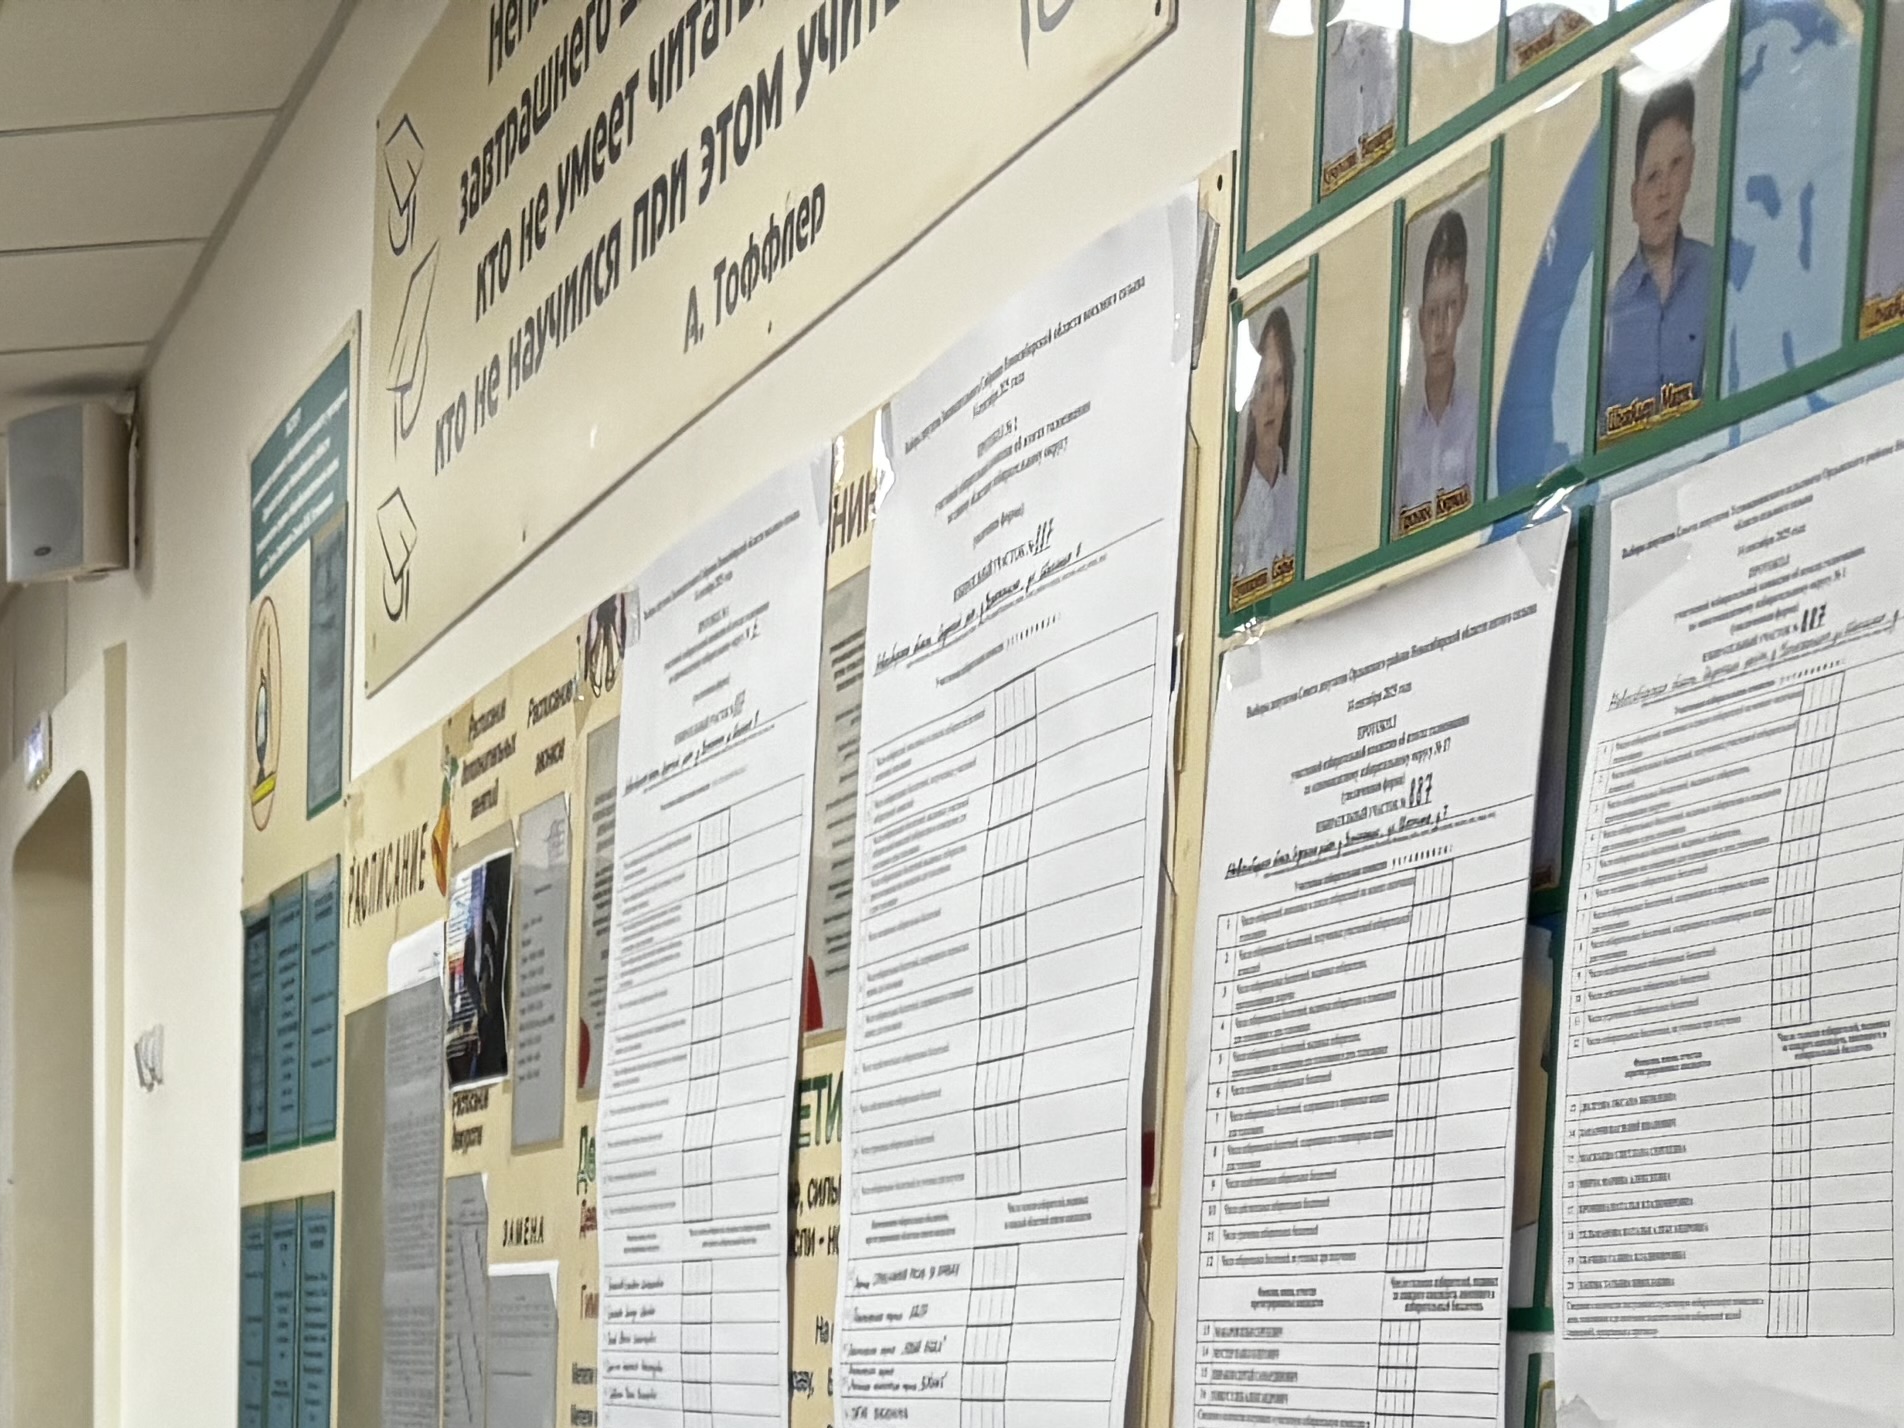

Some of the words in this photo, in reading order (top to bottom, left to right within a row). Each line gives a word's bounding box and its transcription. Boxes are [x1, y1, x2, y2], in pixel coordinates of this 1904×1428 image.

[459, 0, 611, 233] завтрашнего
[475, 228, 512, 322] кто
[518, 188, 548, 272] не
[554, 68, 640, 236] умеет
[434, 390, 468, 477] кто
[473, 353, 502, 436] не
[507, 219, 623, 400] научился
[631, 155, 691, 281] при
[697, 45, 786, 208] этом
[683, 285, 706, 353] А.
[713, 181, 829, 331] Тоффлер
[347, 821, 428, 928] РАСПИСАНИЕ
[503, 1216, 544, 1247] ЗАМЕНА
